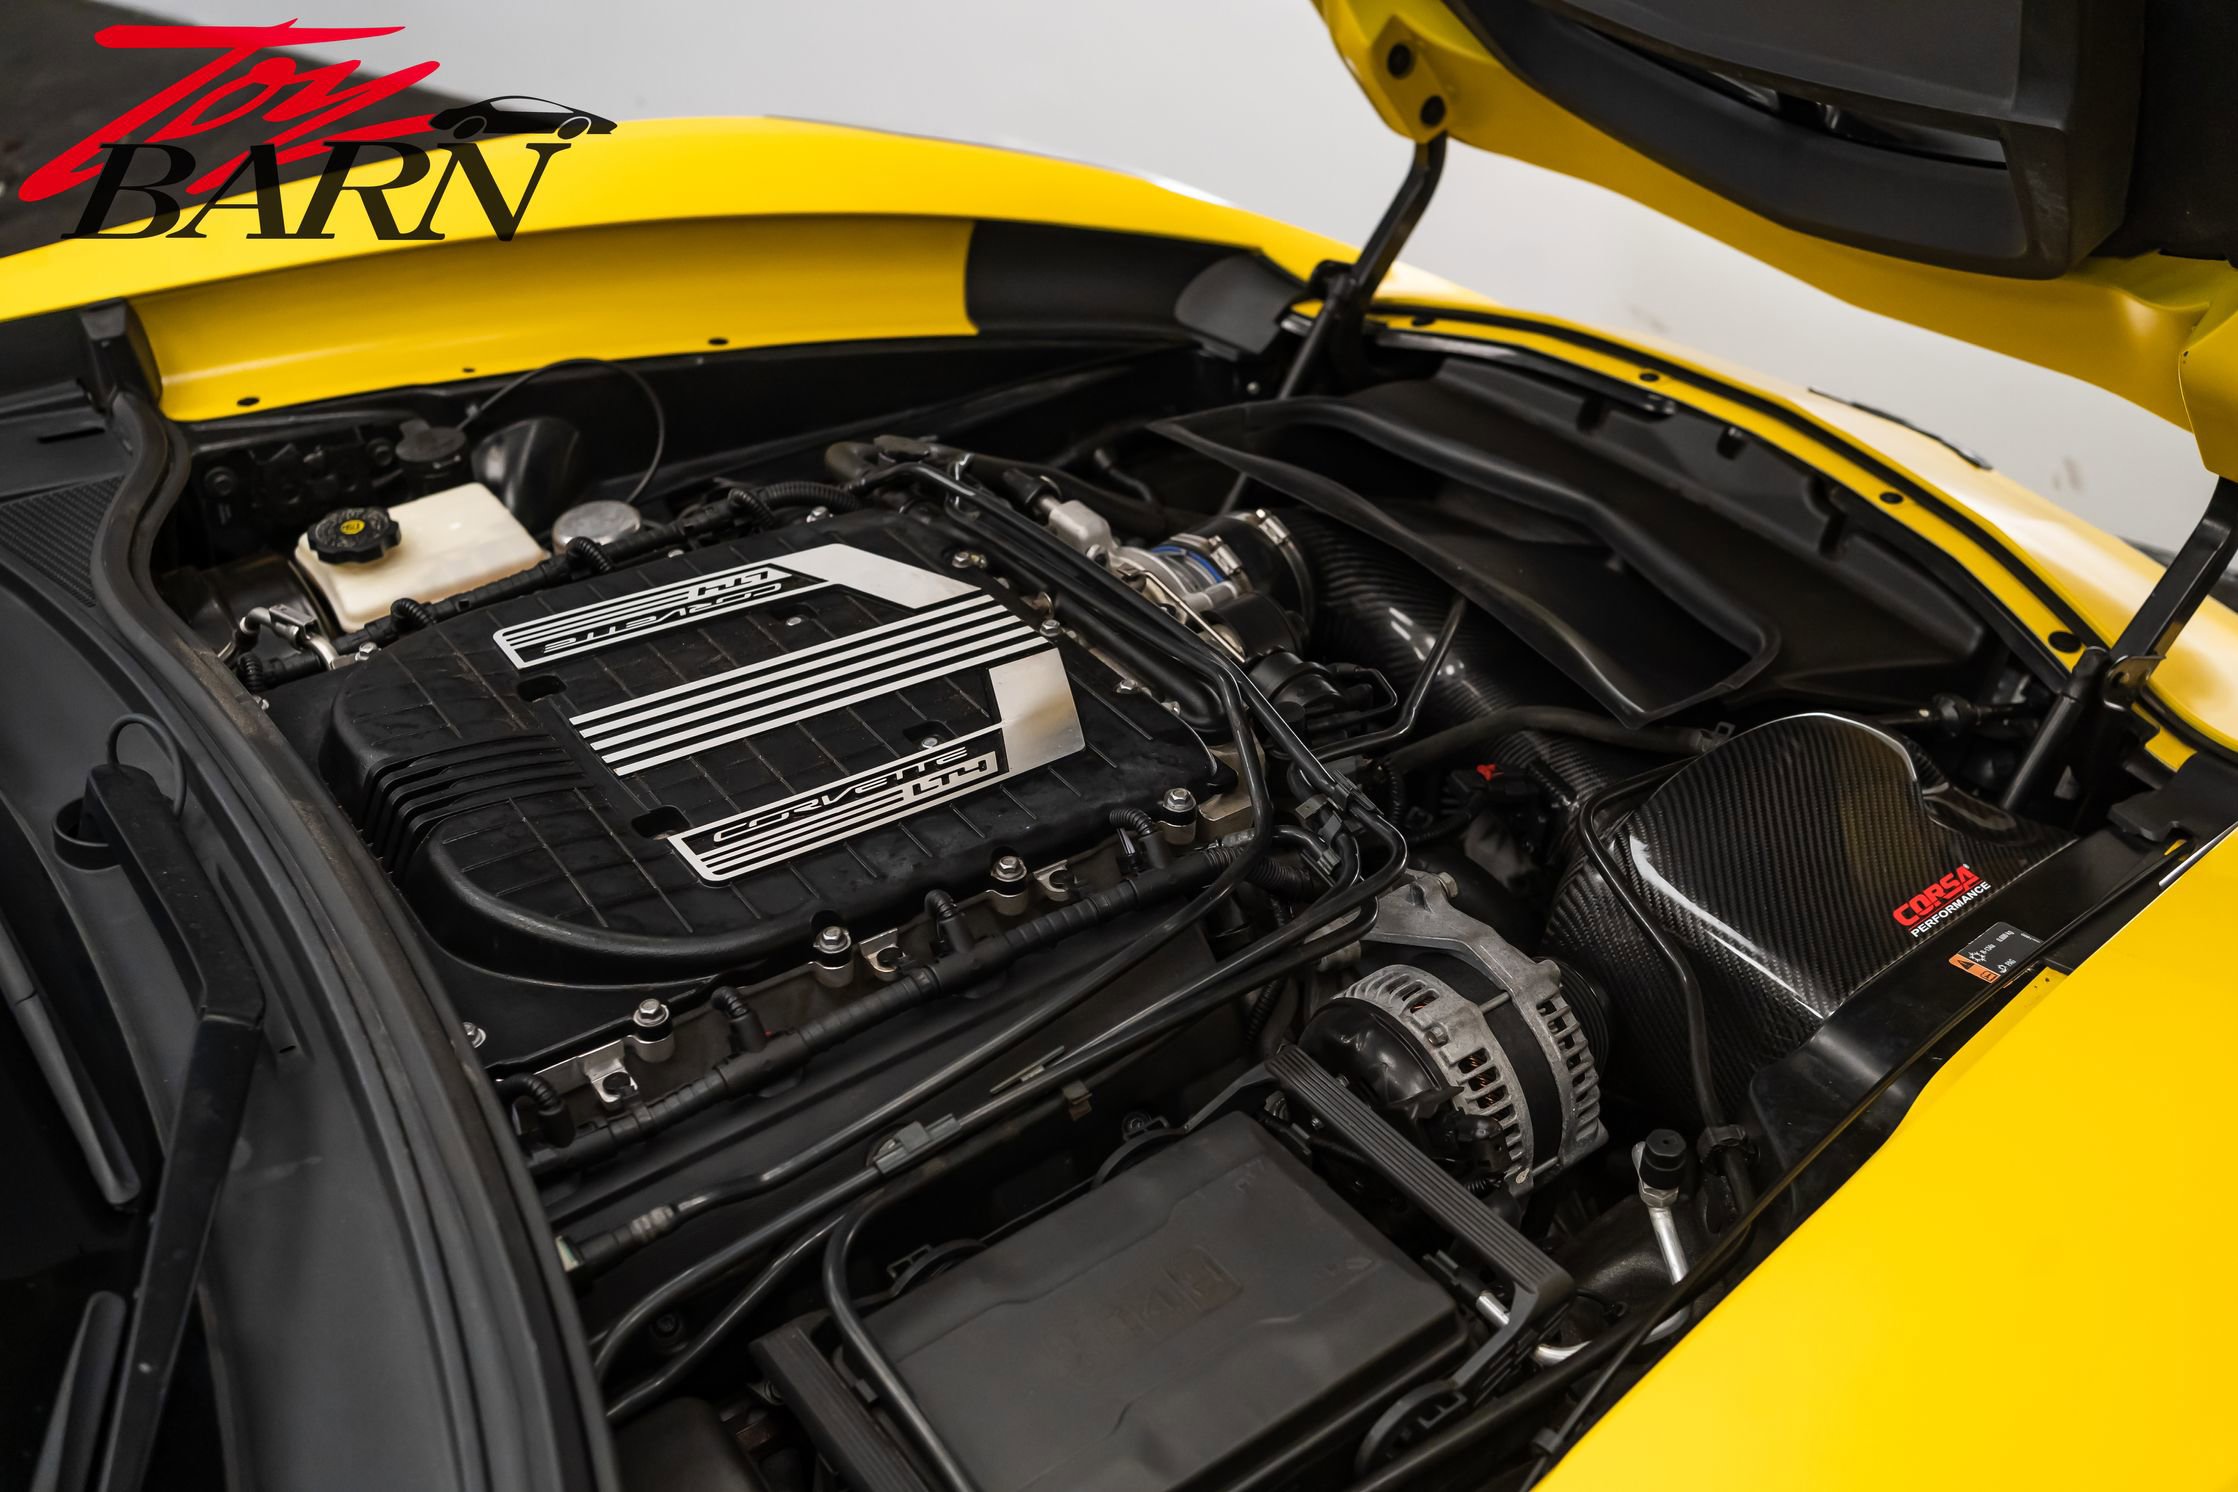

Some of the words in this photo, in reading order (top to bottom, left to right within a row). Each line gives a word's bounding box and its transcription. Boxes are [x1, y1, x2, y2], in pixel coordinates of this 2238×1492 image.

[694, 569, 770, 601] LT4
[543, 582, 782, 654] CORVETTE
[713, 746, 968, 843] CORVETTE
[911, 758, 987, 798] LT4
[1892, 864, 1980, 926] CORSA
[1910, 881, 1992, 938] PERFORMANCE
